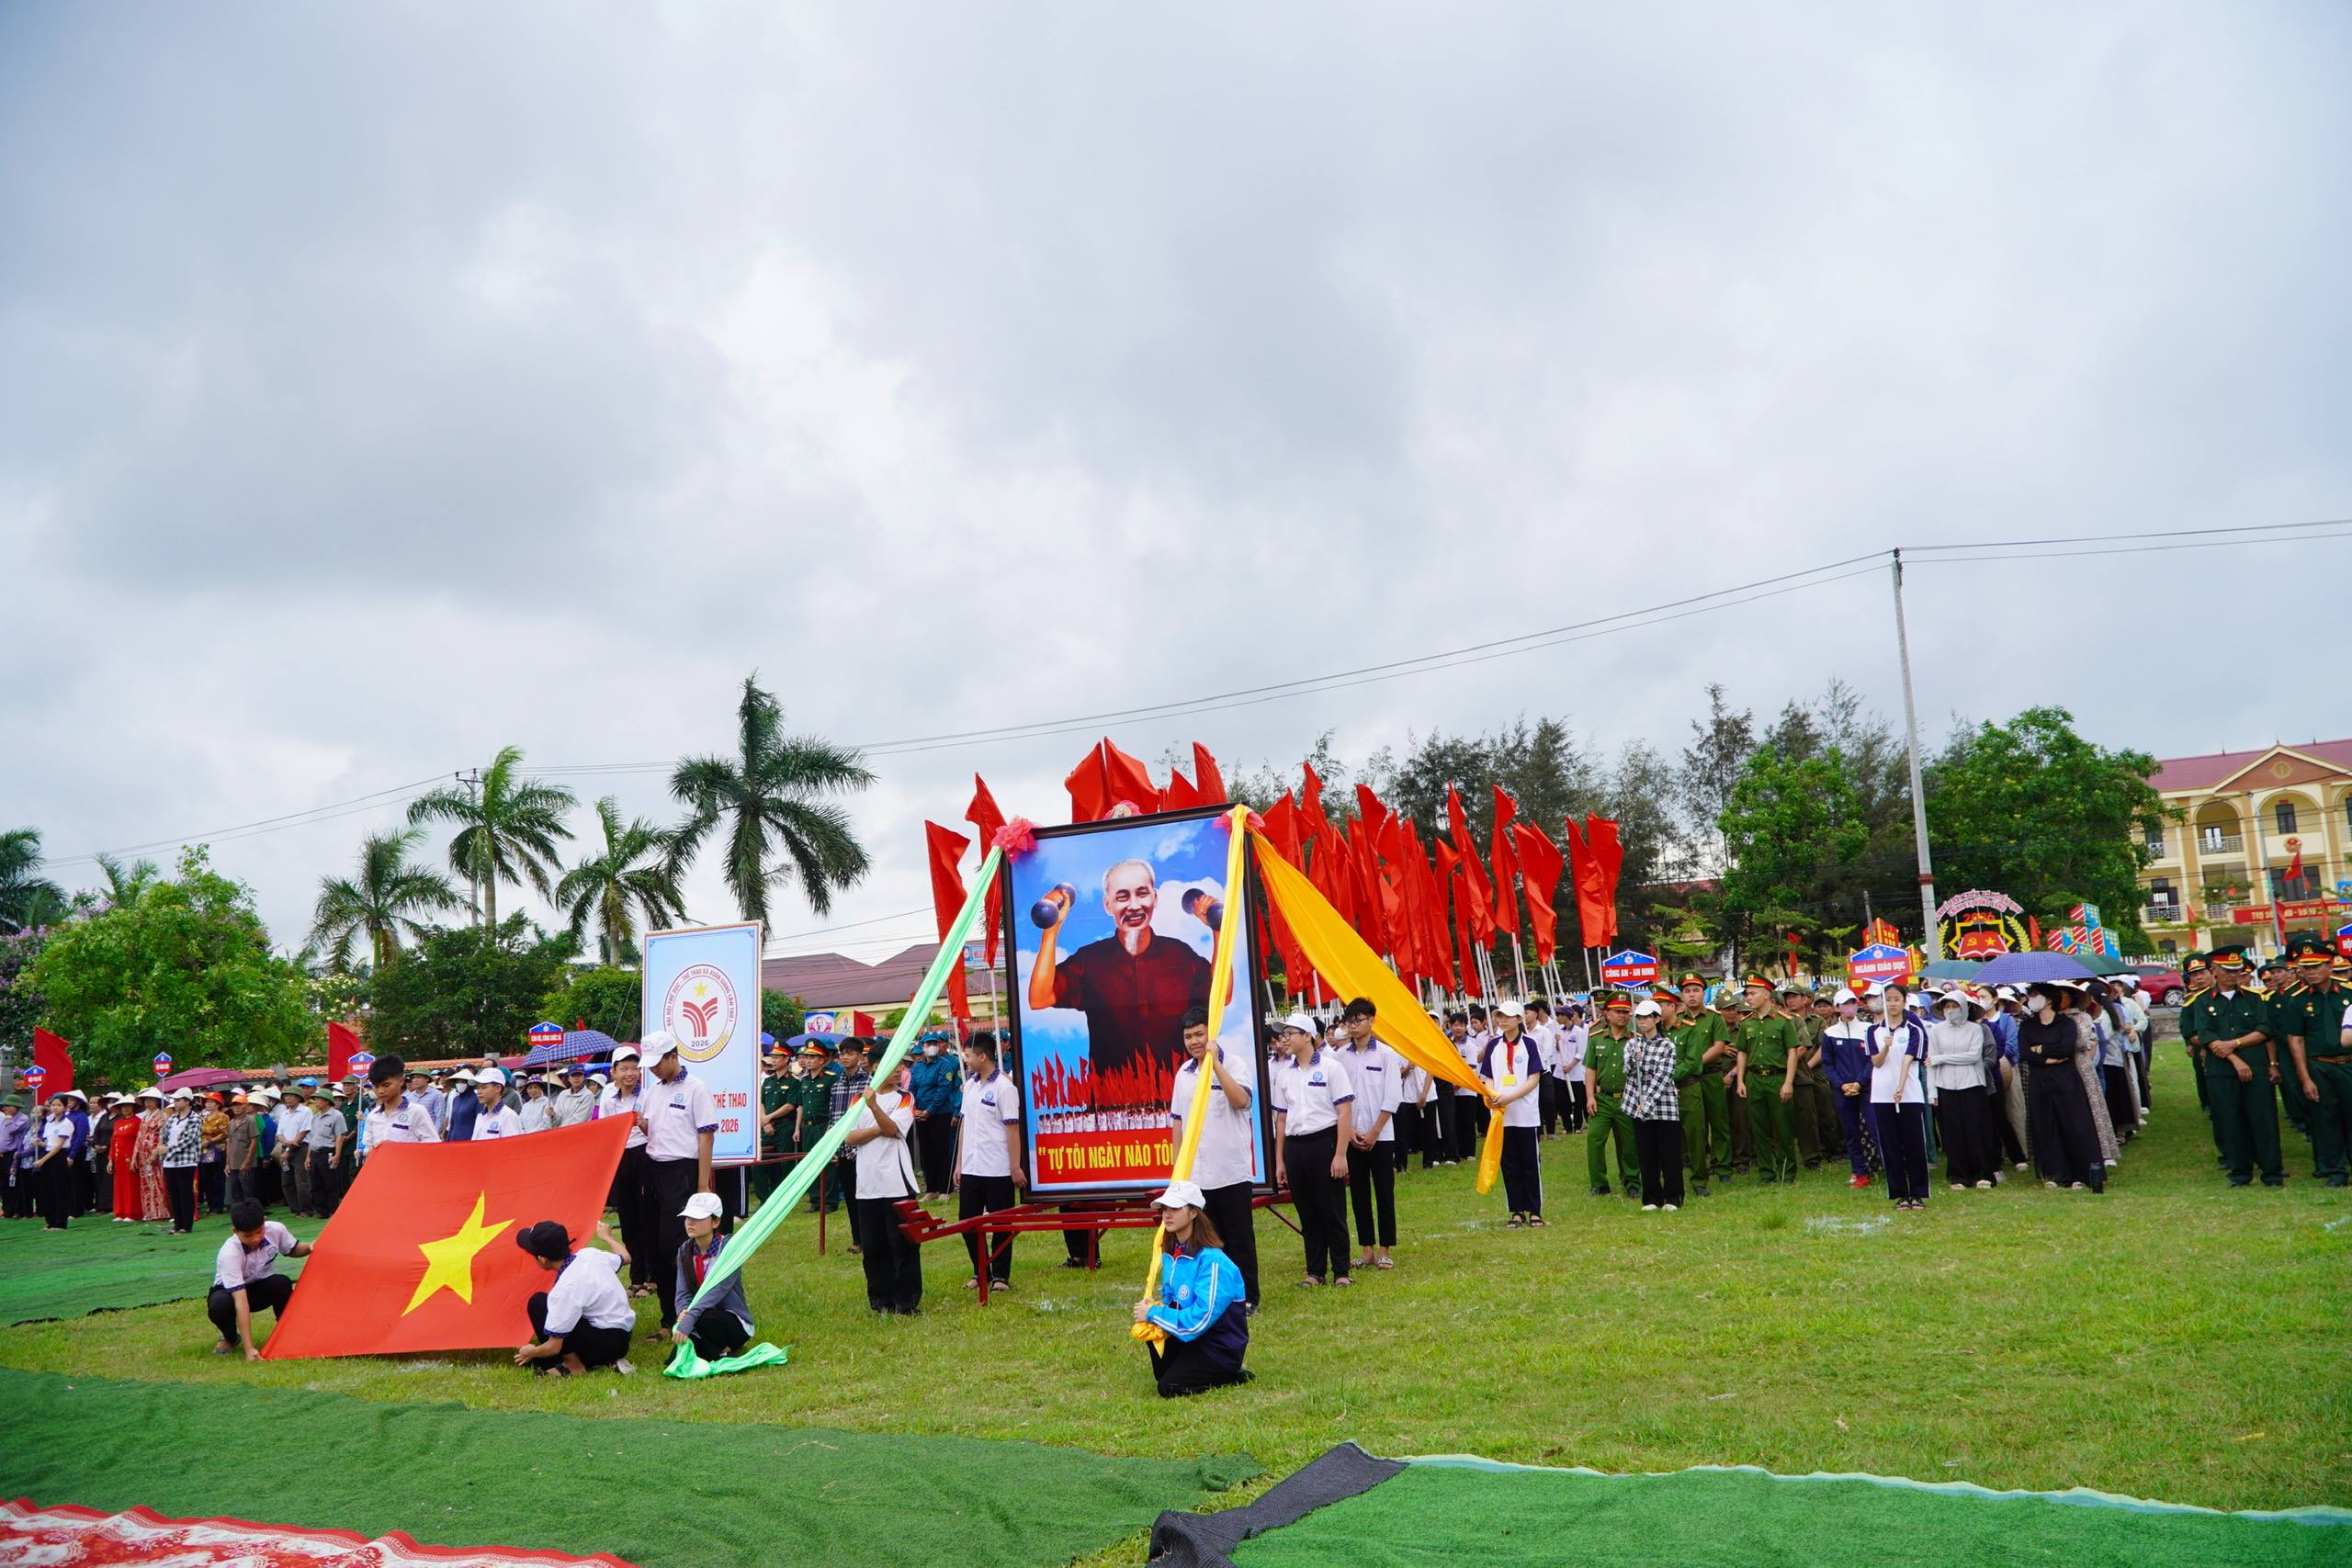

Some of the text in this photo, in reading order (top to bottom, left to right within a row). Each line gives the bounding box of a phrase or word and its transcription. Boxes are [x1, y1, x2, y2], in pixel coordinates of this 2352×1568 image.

[1877, 961, 1892, 972] GIÁO
[1893, 961, 1905, 971] DỤC
[729, 1093, 747, 1108] THAO
[720, 1119, 739, 1133] 2026
[1066, 1143, 1085, 1169] TÔI
[1089, 1142, 1122, 1169] NGÀY
[1125, 1140, 1151, 1167] NÀO
